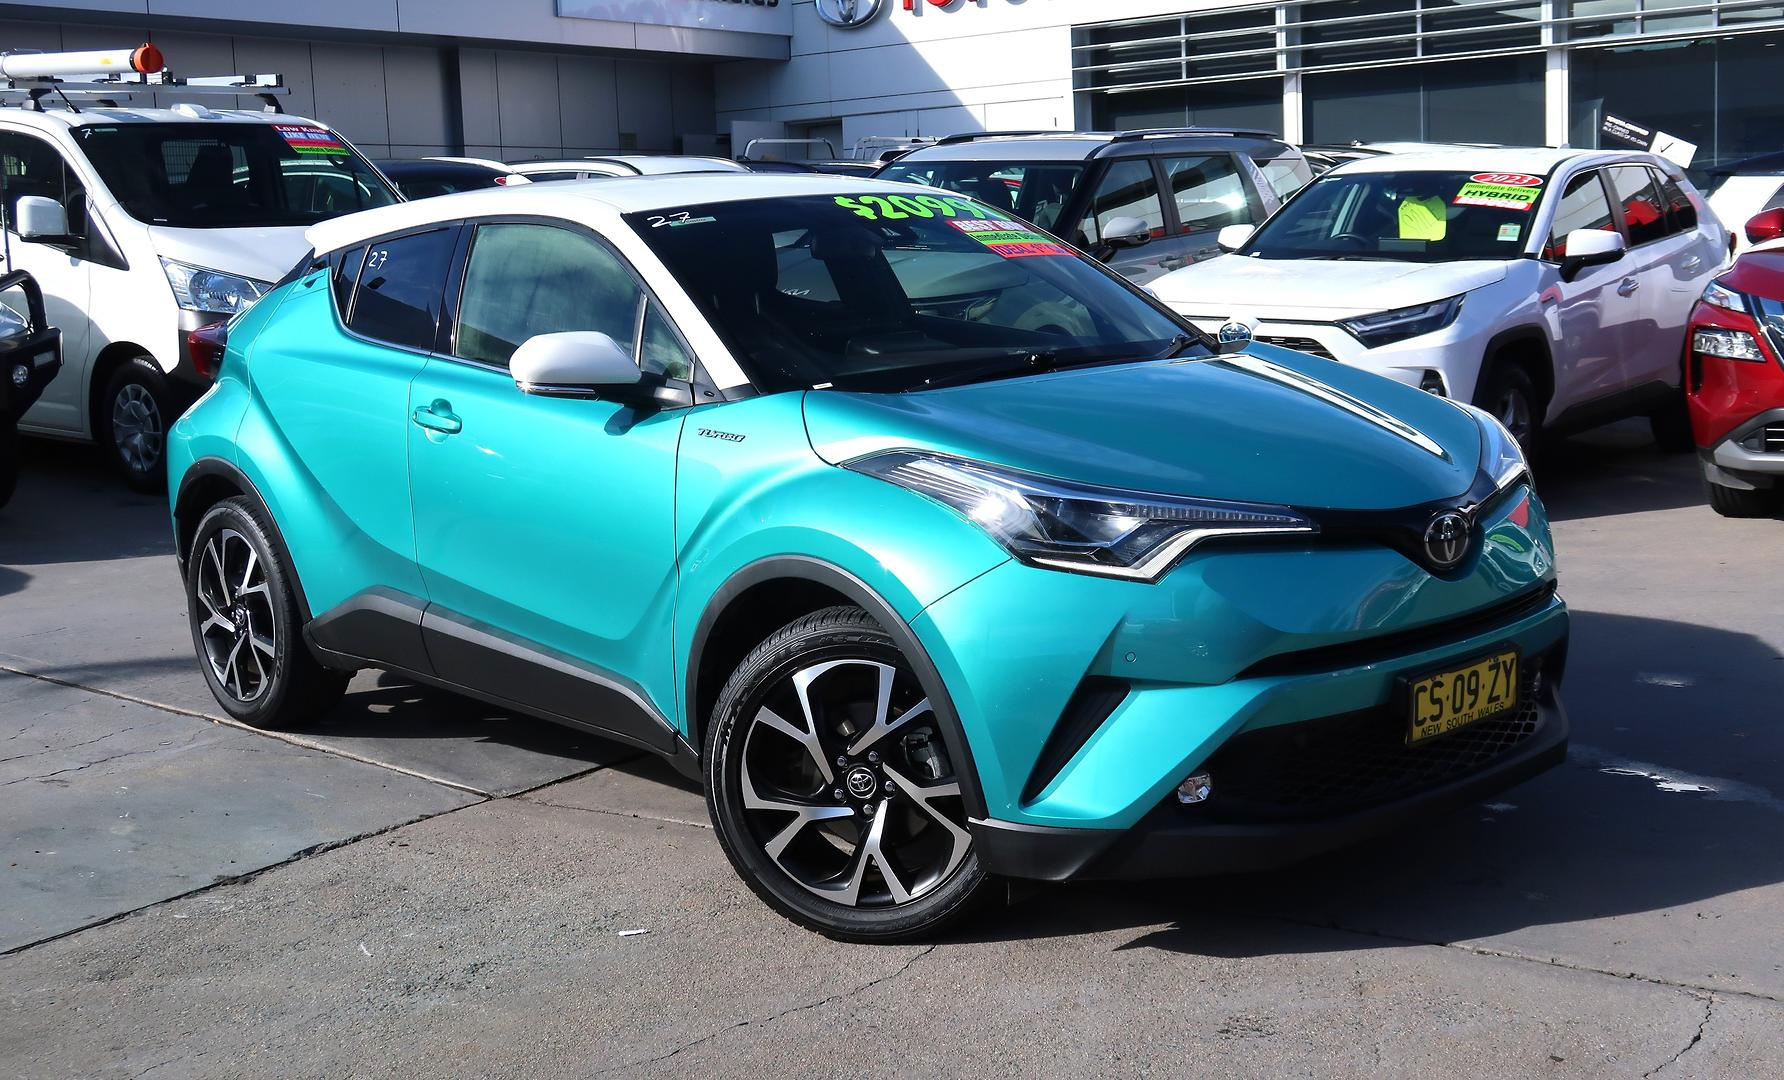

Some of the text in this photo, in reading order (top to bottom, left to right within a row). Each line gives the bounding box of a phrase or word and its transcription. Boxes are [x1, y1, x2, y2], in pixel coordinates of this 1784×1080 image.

[1482, 173, 1531, 185] 2023
[1464, 190, 1531, 201] HYBRID
[1465, 183, 1539, 195] Immediate Delivery
[833, 195, 1008, 221] $2099
[951, 220, 994, 231] BEST
[368, 250, 388, 270] 27
[698, 428, 746, 443] TURBO
[1421, 701, 1505, 737] NEW SOUTH WALES
